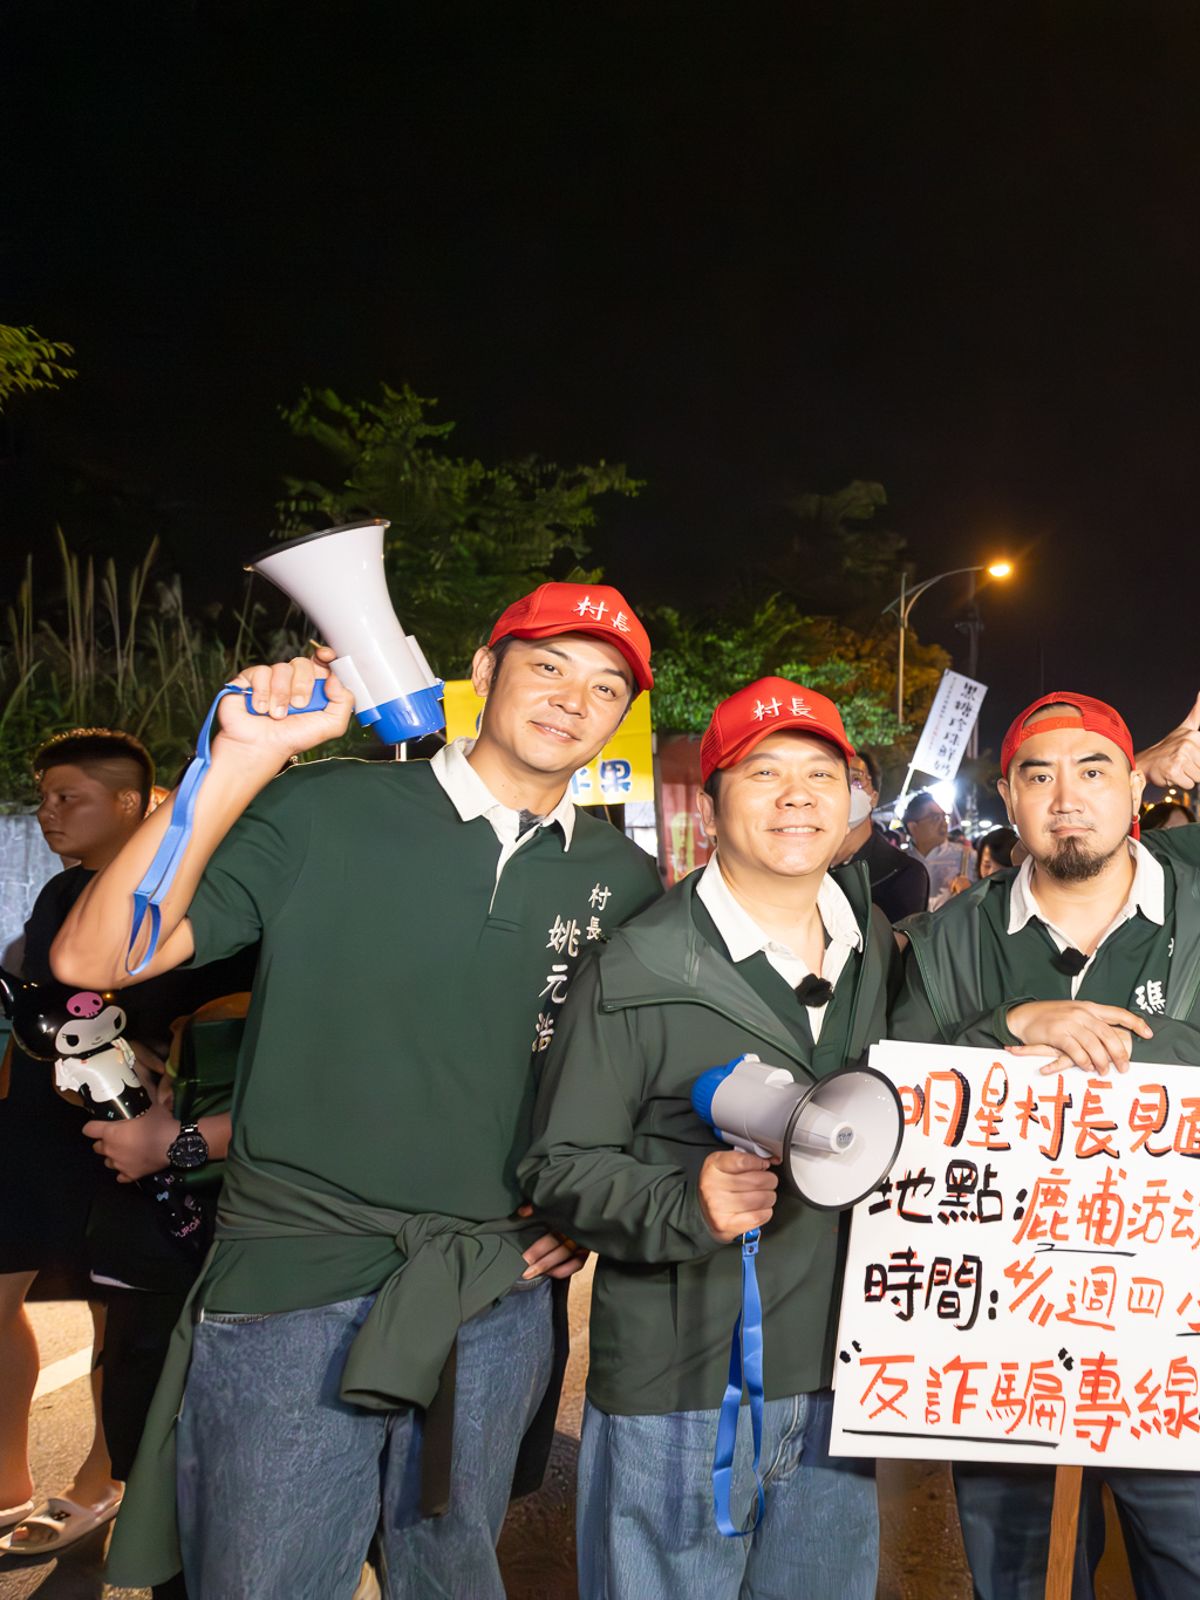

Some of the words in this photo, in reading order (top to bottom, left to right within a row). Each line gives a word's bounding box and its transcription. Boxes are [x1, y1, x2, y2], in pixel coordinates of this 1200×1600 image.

[574, 596, 631, 632] 村長
[753, 696, 817, 721] 村長
[586, 882, 612, 941] 村長
